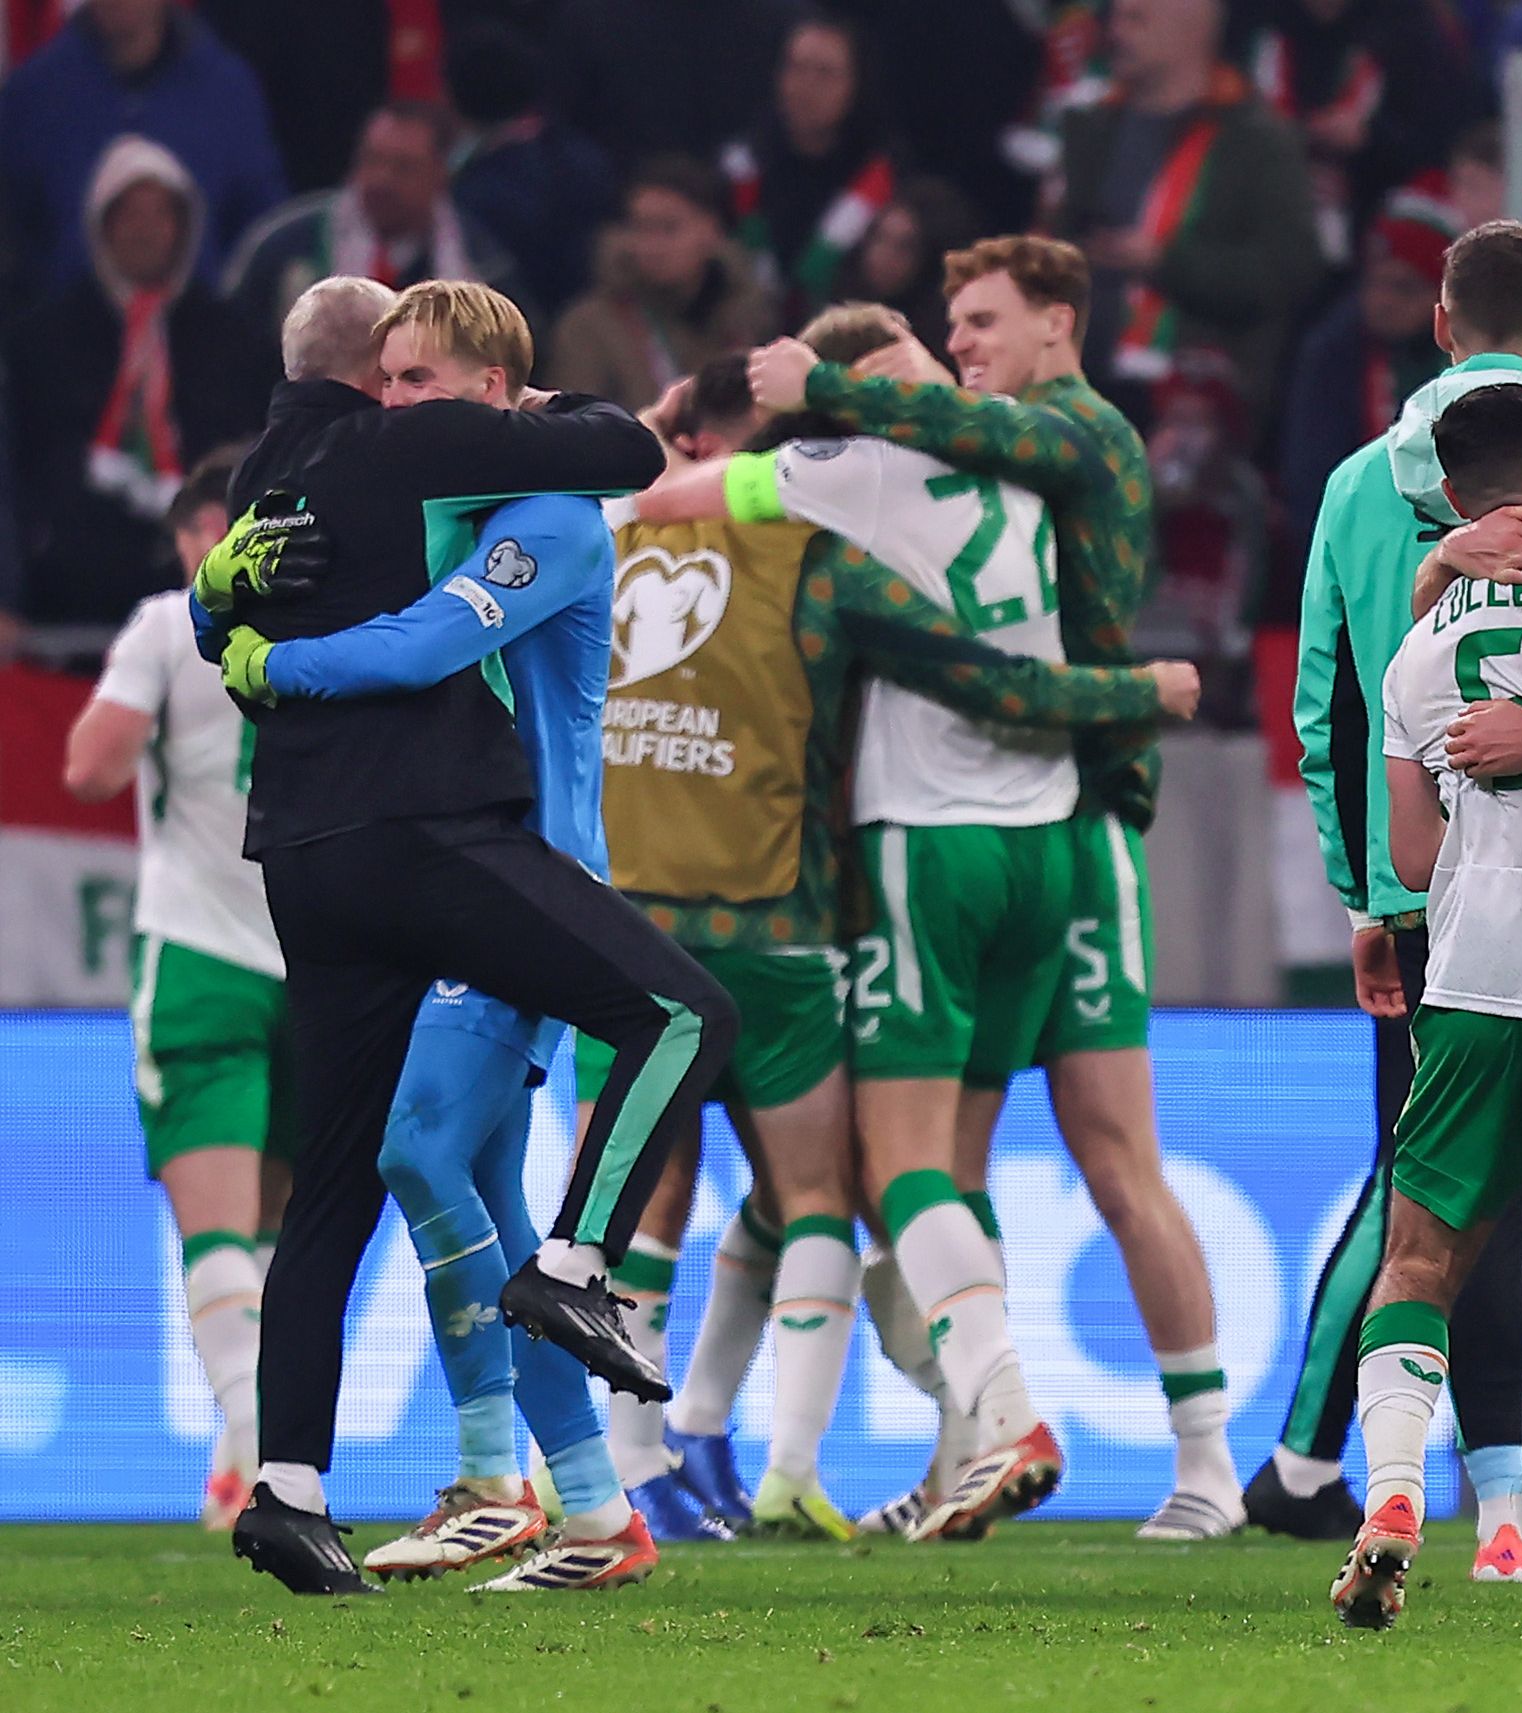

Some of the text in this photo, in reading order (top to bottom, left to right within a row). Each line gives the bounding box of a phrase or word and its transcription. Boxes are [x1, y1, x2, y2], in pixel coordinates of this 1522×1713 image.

[925, 472, 1058, 634] 2
[603, 699, 720, 737] UROPEAN
[602, 732, 736, 777] ALIFIERS
[856, 936, 892, 1009] 2
[1066, 919, 1108, 991] 5
